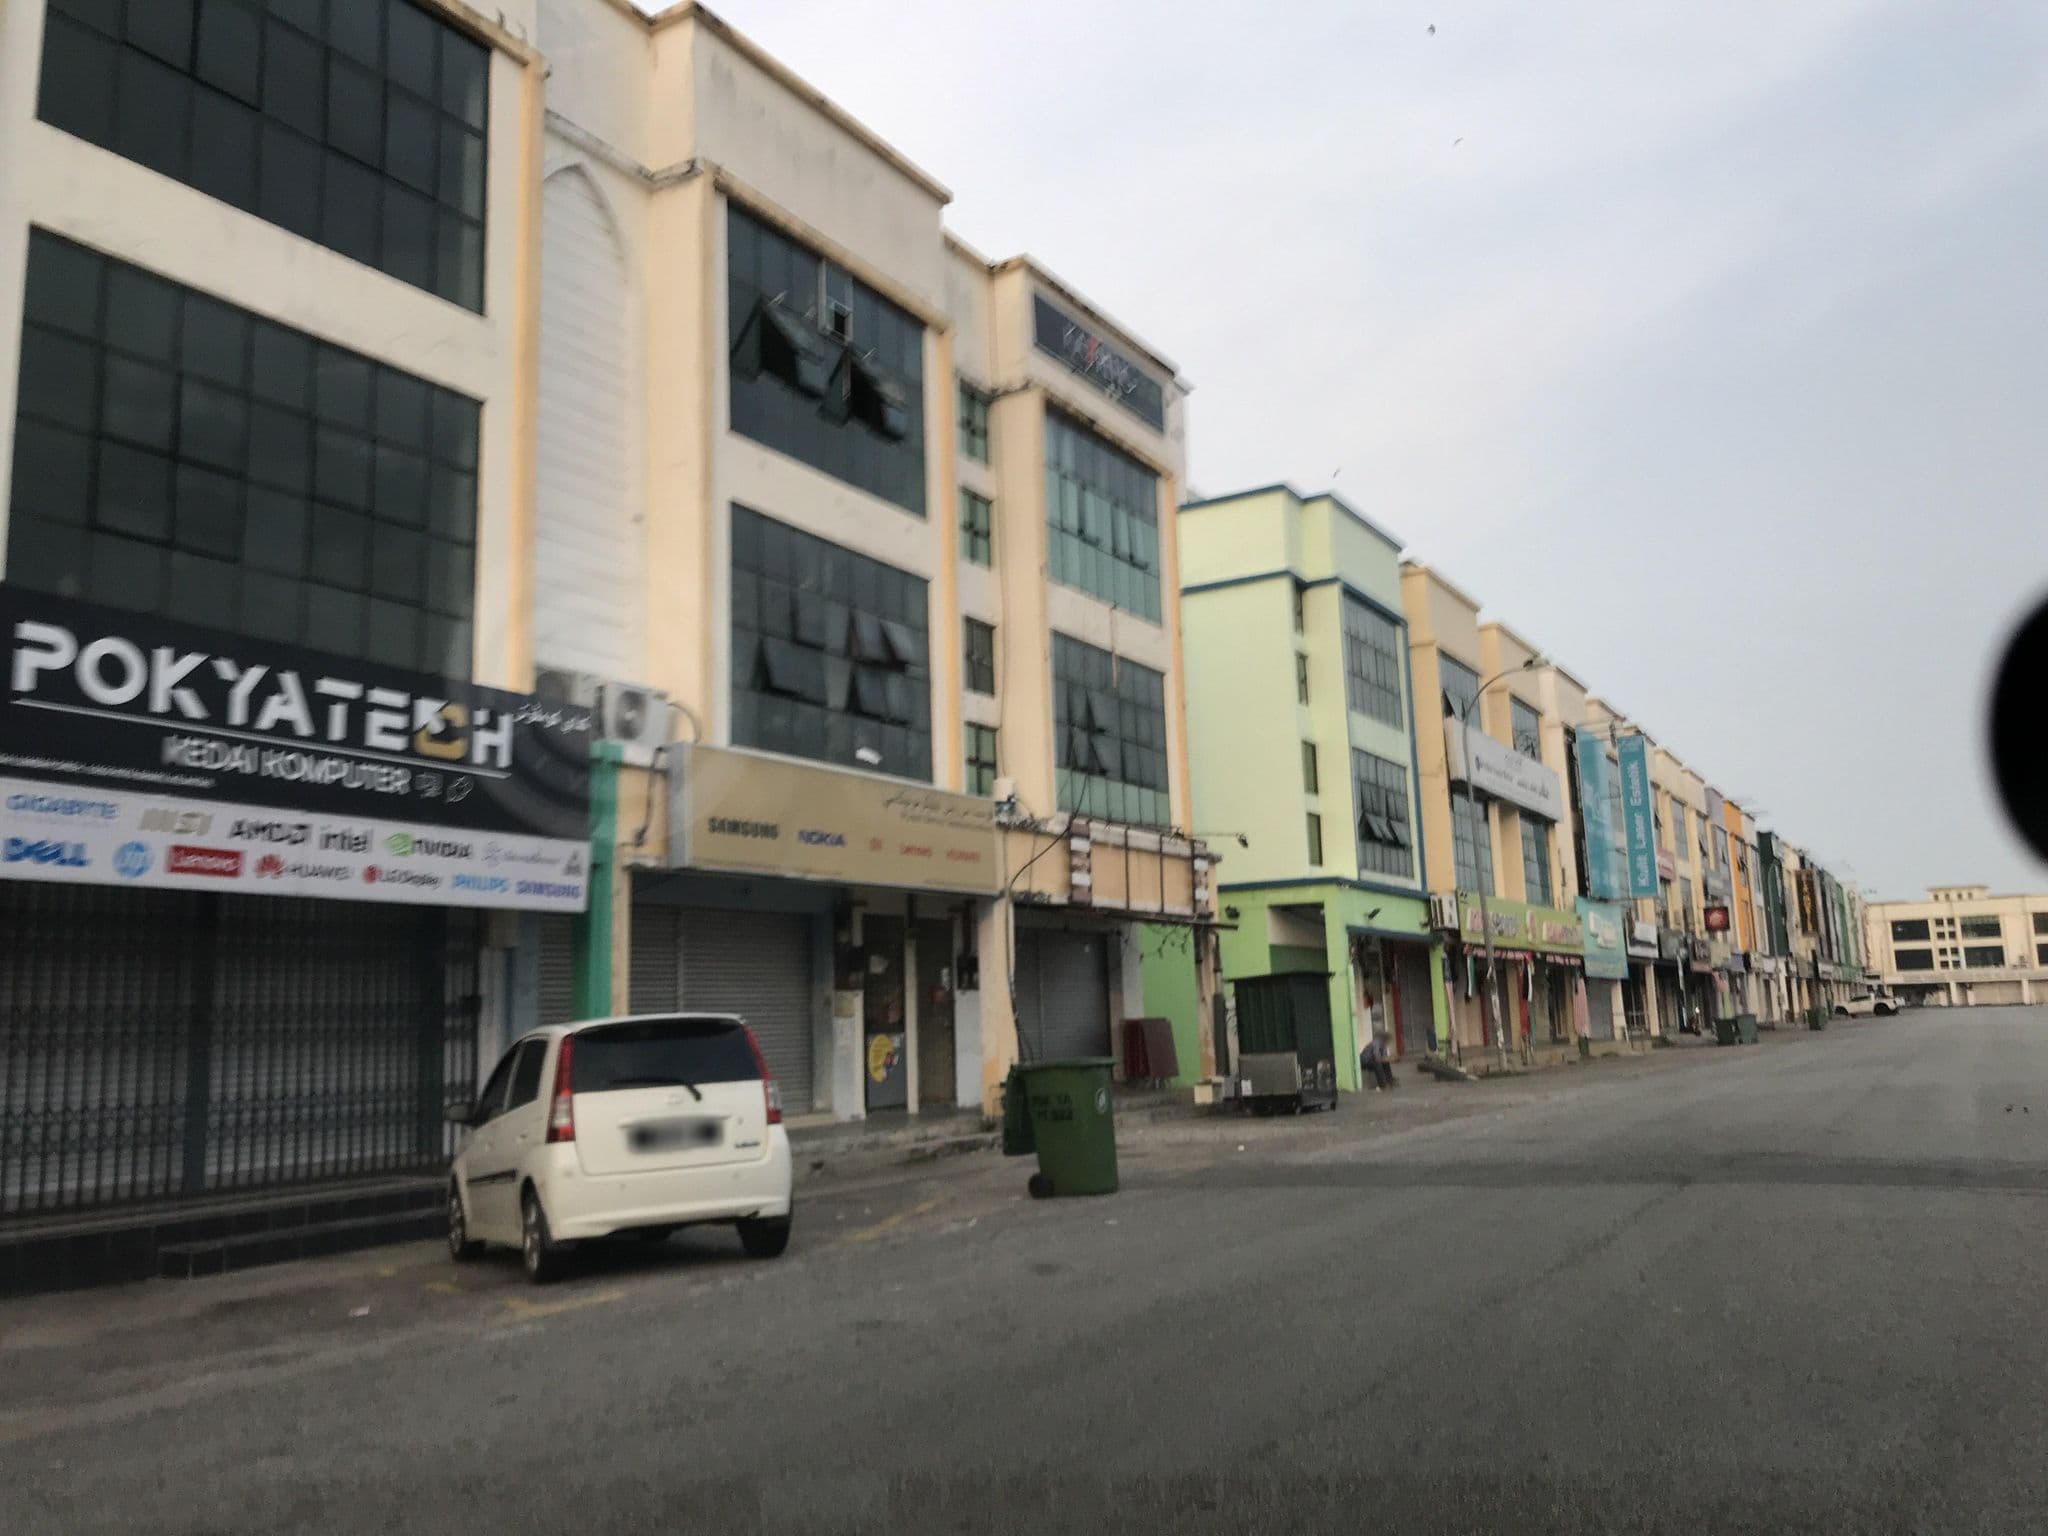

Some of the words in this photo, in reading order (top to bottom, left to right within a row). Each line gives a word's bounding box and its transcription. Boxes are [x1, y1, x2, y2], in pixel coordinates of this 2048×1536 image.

[11, 620, 514, 769] POKYATECH
[161, 736, 258, 775] KEDAI
[259, 750, 411, 795] KOMPUTER
[707, 815, 779, 841] SAMSUNG
[799, 828, 846, 848] NOKIA
[2, 837, 89, 867] DELL
